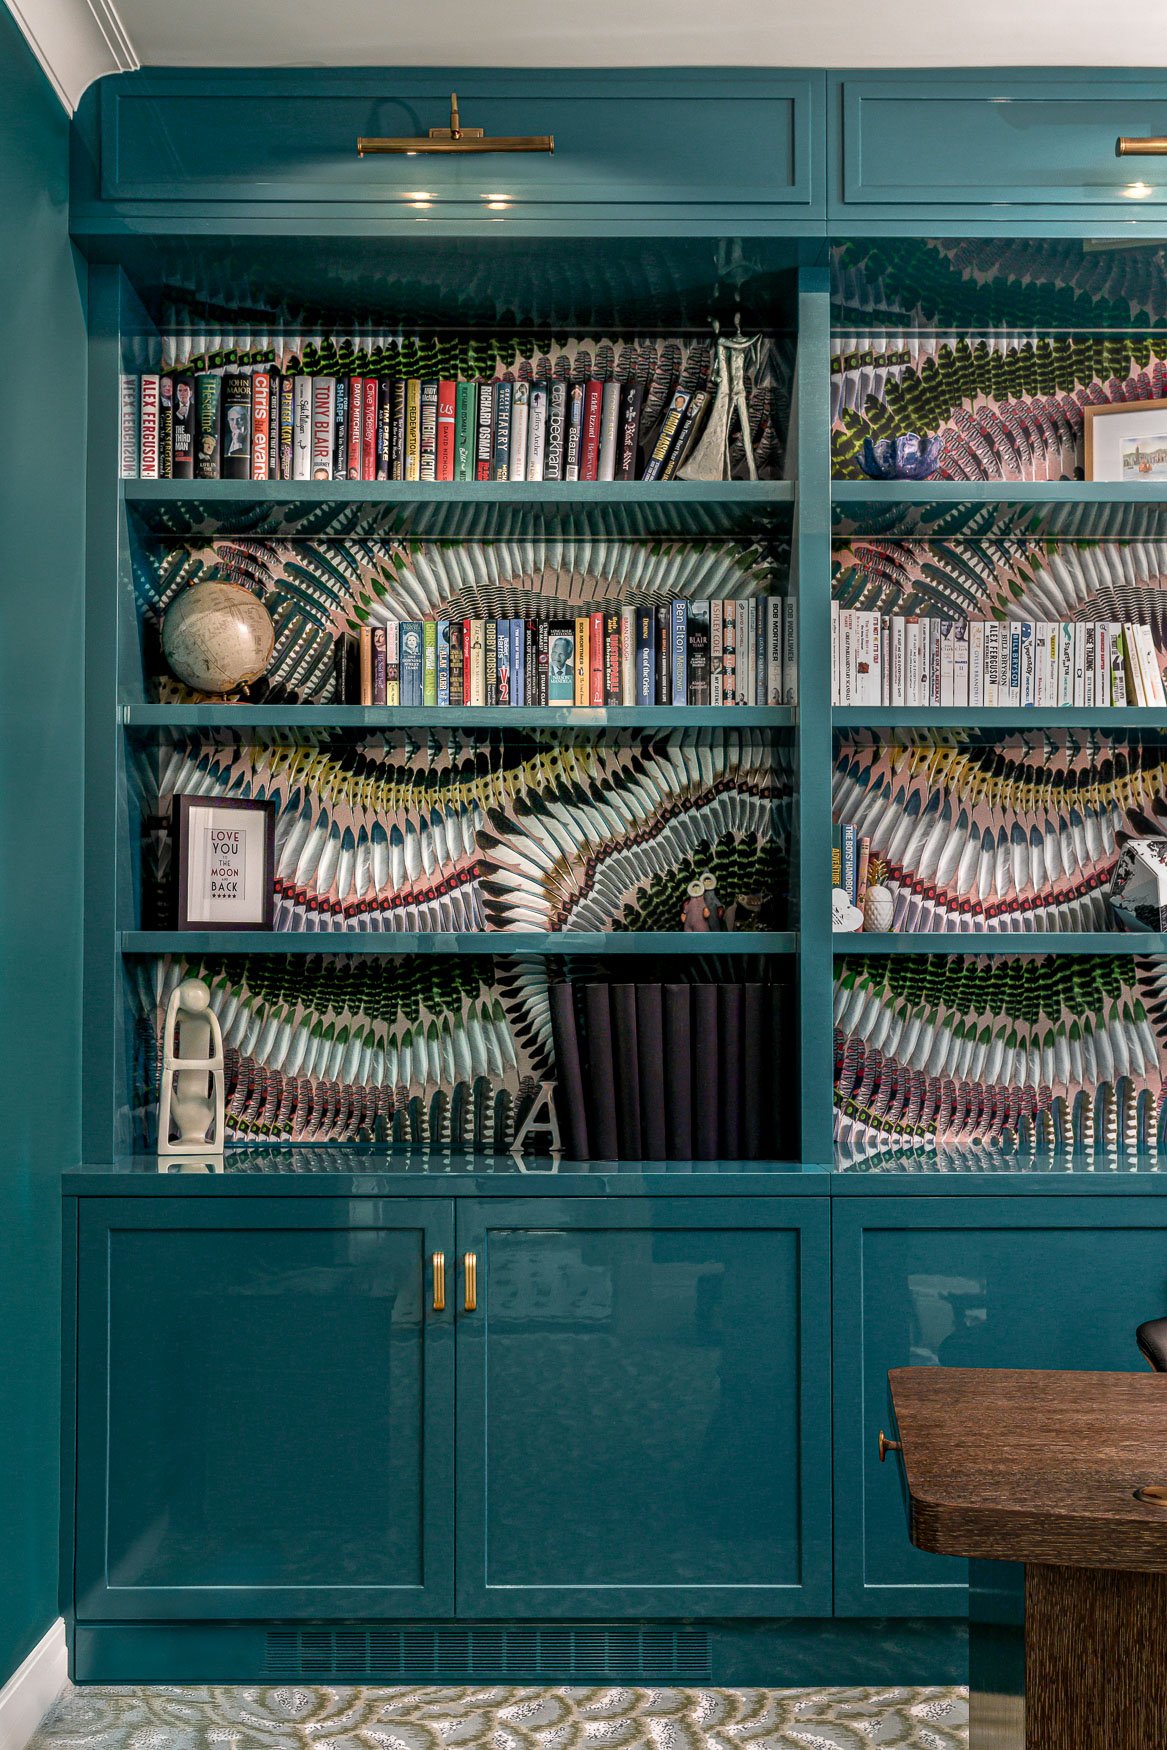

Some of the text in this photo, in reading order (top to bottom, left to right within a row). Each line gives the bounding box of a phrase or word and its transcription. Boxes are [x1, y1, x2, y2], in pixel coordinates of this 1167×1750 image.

[143, 380, 156, 408] ALEX
[255, 377, 268, 419] chris
[281, 393, 293, 422] PETER
[336, 383, 344, 423] SHARPE
[394, 383, 403, 419] DIANA
[201, 384, 216, 433] Heseltine
[314, 386, 330, 457] TONY BLAIR
[365, 383, 374, 442] Clive Tyldesley
[175, 426, 185, 434] THE
[281, 426, 292, 444] KAY
[352, 408, 360, 444] MITCHELL
[409, 406, 417, 455] REDEMPTION
[422, 406, 436, 452] IMMEDIATE
[498, 412, 509, 451] HARRY
[533, 410, 542, 456] Jeffrey Archer
[589, 415, 598, 438] Izzard
[663, 411, 681, 435] DAVID
[679, 429, 688, 440] Time
[142, 412, 155, 472] FERGUSON
[175, 434, 190, 442] THIRD
[175, 442, 188, 450] MAN
[382, 425, 390, 462] PEAKE
[479, 427, 490, 459] OSMAN
[568, 428, 578, 463] adams
[652, 433, 671, 461] JASON
[675, 440, 683, 450] Next
[255, 434, 266, 480] evans
[671, 451, 679, 460] Year
[426, 624, 435, 646] CHRIS
[539, 624, 544, 634] ON
[989, 624, 998, 643] ALEX
[486, 623, 496, 684] BOBBY ROBSON
[676, 603, 685, 692] Ben Elton Meltdown
[713, 635, 721, 654] COLE
[439, 650, 447, 690] ALAN CARR
[642, 659, 650, 667] of
[642, 667, 650, 677] the
[935, 658, 939, 666] ON
[989, 646, 997, 685] FERGUSON
[426, 670, 434, 695] EVANS
[642, 678, 650, 696] Crisis
[714, 676, 719, 685] MY
[211, 831, 239, 842] LOVE
[845, 825, 853, 840] THE
[212, 843, 238, 855] YOU
[211, 869, 239, 877] MOON
[832, 848, 842, 885] ADVENTURE
[211, 882, 237, 891] BACK
[509, 1082, 562, 1150] A
